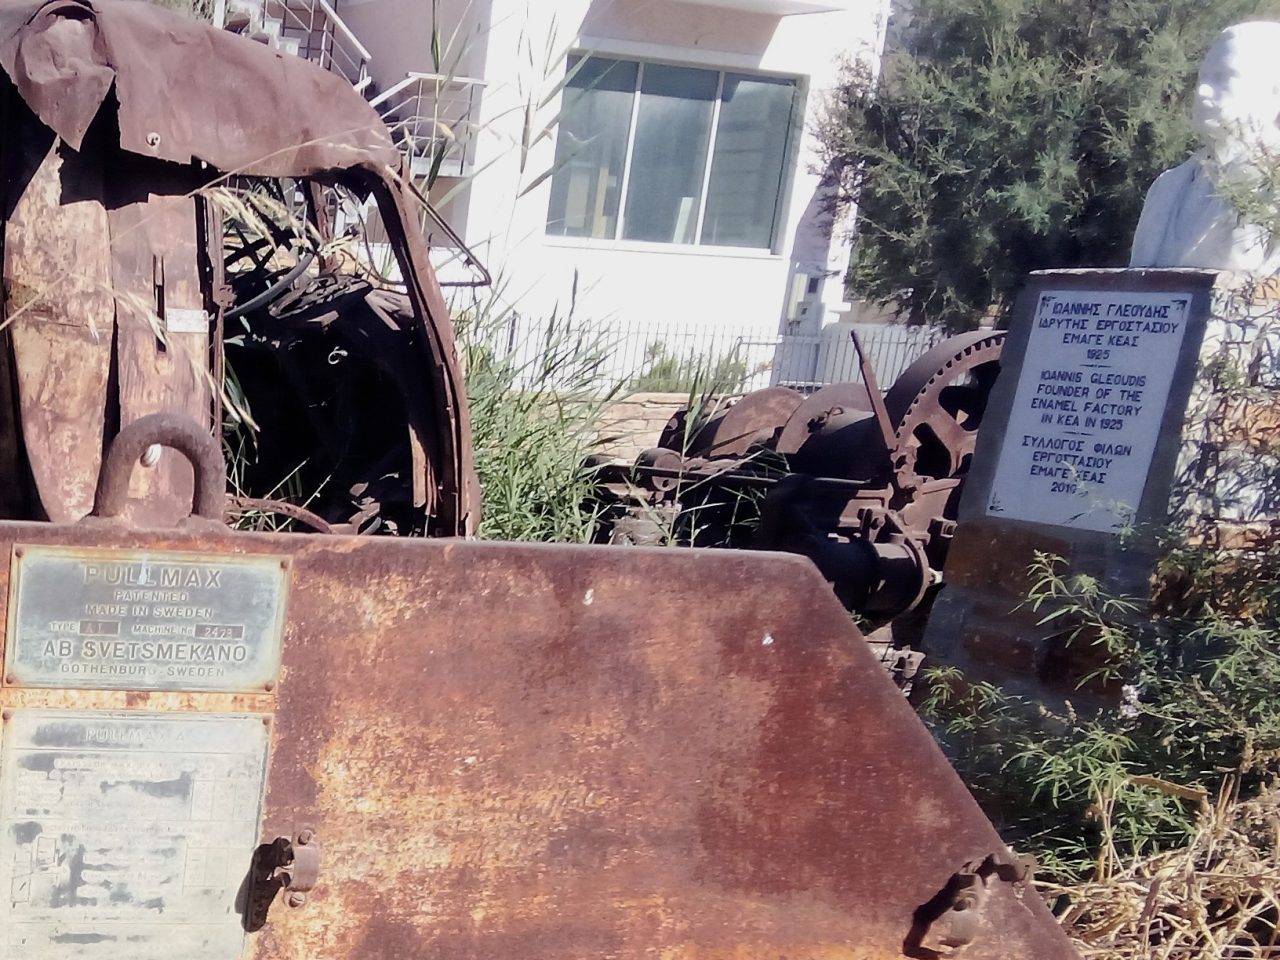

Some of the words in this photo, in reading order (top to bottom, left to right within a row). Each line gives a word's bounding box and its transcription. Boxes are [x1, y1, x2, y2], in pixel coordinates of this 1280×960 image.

[1053, 301, 1100, 316] ΙΩΑΝΝΗΣ
[1107, 303, 1170, 318] ΓΛΕΟΥΔΗΣ
[1039, 318, 1089, 330] ΙΔΡΥΤΗΣ
[1096, 320, 1179, 333] ΕΡΓΟΣΤΑΣΙΟΥ
[1063, 333, 1103, 345] ΕΜΑΓΕ
[1108, 334, 1139, 347] ΚΕΑΣ
[1087, 348, 1110, 360] 1925
[1041, 370, 1082, 383] IOANNIS
[1091, 372, 1146, 386] GLEOUDIS
[1037, 384, 1089, 398] FOUNDER
[1096, 388, 1110, 399] OF
[1121, 389, 1143, 402] THE
[1031, 398, 1077, 412] ENAMEL
[1084, 402, 1142, 417] FACTORY
[1041, 413, 1052, 424] IN
[1057, 415, 1079, 427] KEA
[1086, 416, 1096, 428] IN
[1100, 418, 1123, 430] 1925
[1022, 435, 1085, 452] ΣΥΛΛΟΓΟΣ
[1094, 442, 1131, 456] ΦΙΛΩΝ
[1033, 452, 1112, 469] ΕΡΓΟΣΤΑΣΙΟΥ
[1030, 465, 1069, 479] ΕΜΑΓΕ
[83, 565, 222, 588] PULLMAX
[114, 590, 189, 602] PATENTED
[86, 604, 127, 616] MADE
[132, 606, 148, 617] IN
[154, 606, 213, 618] SWEDEN
[49, 622, 76, 632] TYPE
[132, 624, 177, 634] MACHINE
[44, 640, 72, 657] AB
[82, 640, 248, 662] SVETSMEKANO
[167, 666, 225, 677] SWEDEN
